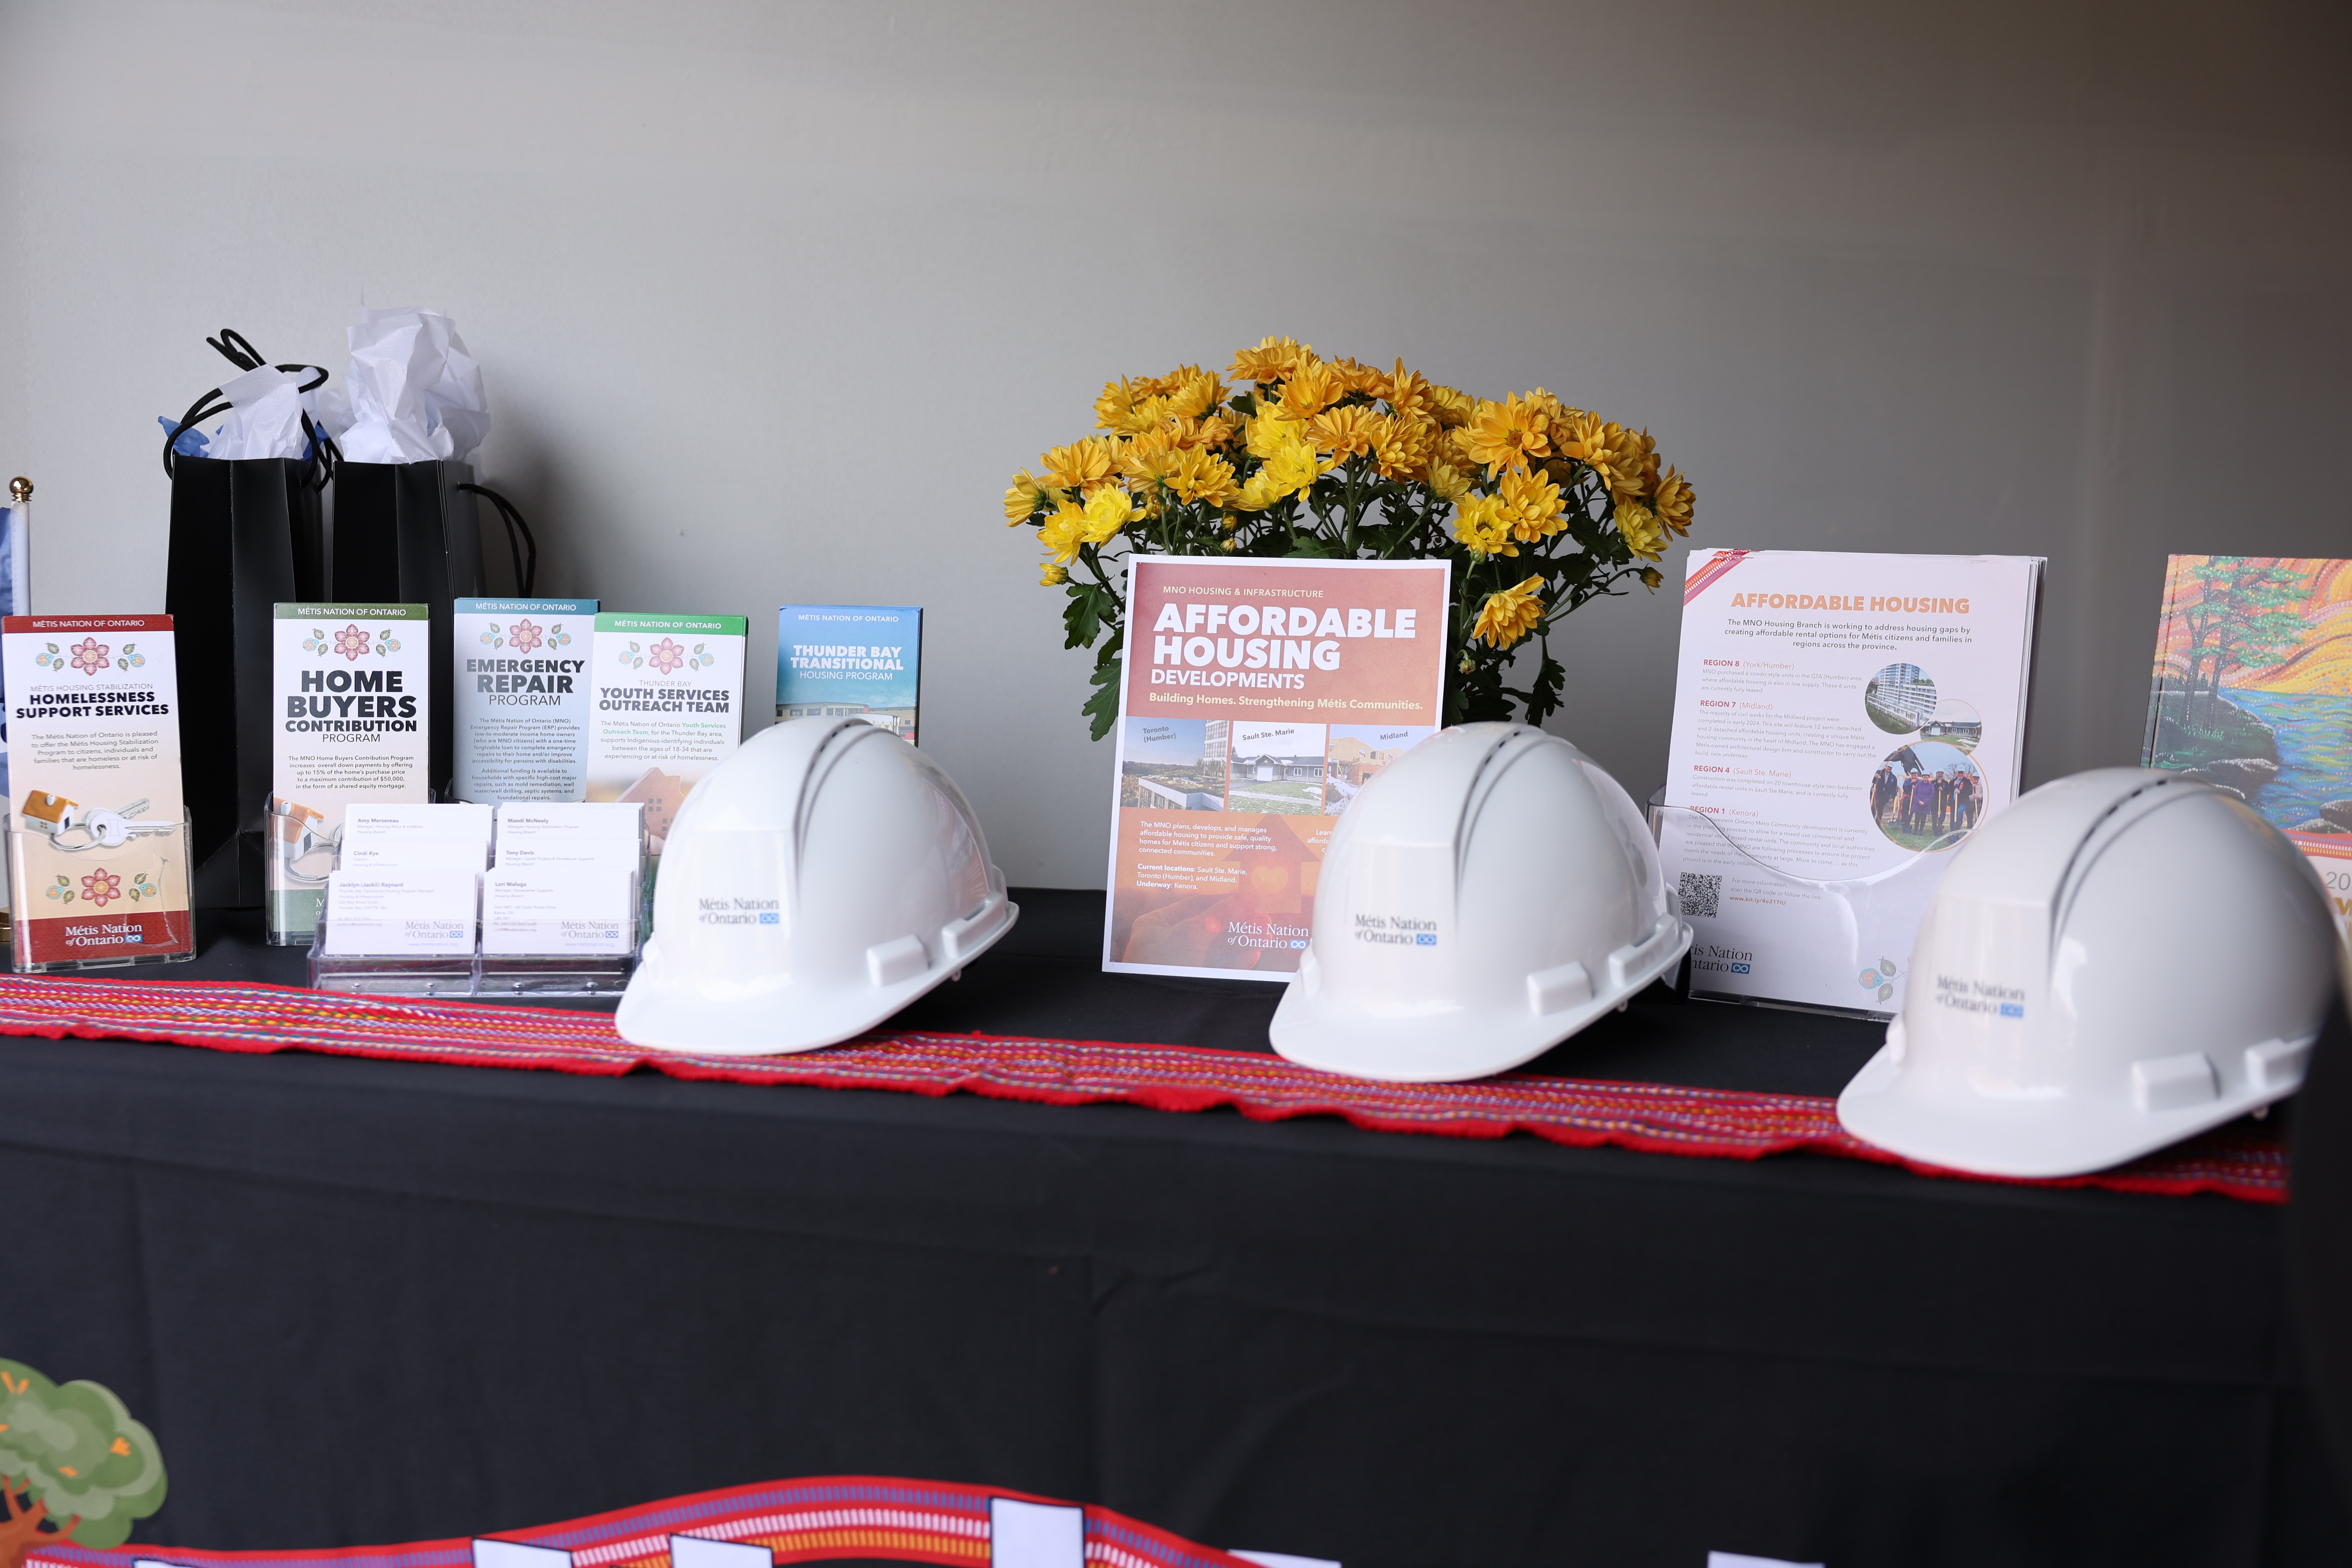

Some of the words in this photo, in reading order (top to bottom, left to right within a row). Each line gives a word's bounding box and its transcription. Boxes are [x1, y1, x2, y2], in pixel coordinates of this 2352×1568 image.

[1189, 587, 1231, 595] HOUSING
[1244, 588, 1323, 597] INFRASTRUCTURE
[1730, 593, 1864, 611] AFFORDABLE
[1869, 596, 1969, 614] HOUSING
[1152, 603, 1416, 638] AFFORDABLE
[1764, 620, 1794, 629] Housing
[1832, 622, 1862, 632] working
[1907, 624, 1937, 634] housing
[1961, 626, 1971, 635] by
[793, 644, 867, 657] THUNDER
[871, 646, 902, 658] BAY
[1154, 635, 1340, 671] HOUSING
[467, 659, 585, 673] EMERGENCY
[790, 657, 904, 670] TRANSITIONAL
[1743, 661, 1794, 670] (York/Humber)
[301, 670, 403, 693] HOME
[800, 671, 843, 679] HOUSING
[846, 672, 893, 680] PROGRAM
[1151, 669, 1305, 690] DEVELOPMENTS
[477, 675, 574, 693] REPAIR
[30, 691, 155, 705] HOMELESSNESS
[489, 695, 560, 706] PROGRAM
[600, 688, 653, 699] YOUTH
[657, 688, 730, 701] SERVICES
[1149, 692, 1194, 706] Building
[1196, 694, 1236, 705] Homes.
[1238, 696, 1314, 710] Strengthening
[1317, 699, 1347, 708] Métis
[1350, 699, 1423, 710] Communities.
[16, 706, 91, 719] SUPPORT
[95, 704, 169, 716] SERVICES
[287, 695, 417, 718] BUYERS
[599, 699, 682, 712] OUTREACH
[686, 701, 729, 713] TEAM
[1740, 702, 1773, 710] (Midland)
[285, 720, 417, 732] CONTRIBUTION
[323, 733, 380, 742] PROGRAM
[1144, 733, 1176, 743] (Humber)
[1380, 731, 1408, 740] Midland
[1769, 770, 1791, 778] Marie)
[1729, 809, 1758, 817] (Kenora)
[1192, 823, 1223, 832] develops,
[2326, 871, 2352, 891] 20
[734, 898, 779, 910] Nation
[708, 911, 757, 924] Ontario
[1390, 916, 1437, 930] Nation
[66, 926, 99, 935] Métis
[102, 923, 143, 934] Nation
[405, 921, 430, 929] Métis
[433, 921, 464, 929] Nation
[561, 921, 586, 929] Métis
[588, 921, 619, 929] Nation
[1228, 922, 1262, 934] Métis
[1266, 924, 1309, 936] Nation
[66, 937, 76, 946] of
[75, 935, 124, 946] Ontario
[1228, 936, 1238, 945] of
[1238, 935, 1288, 949] Ontario
[1363, 928, 1414, 944] Ontario
[1708, 946, 1752, 961] Nation
[1693, 960, 1729, 972] ntario
